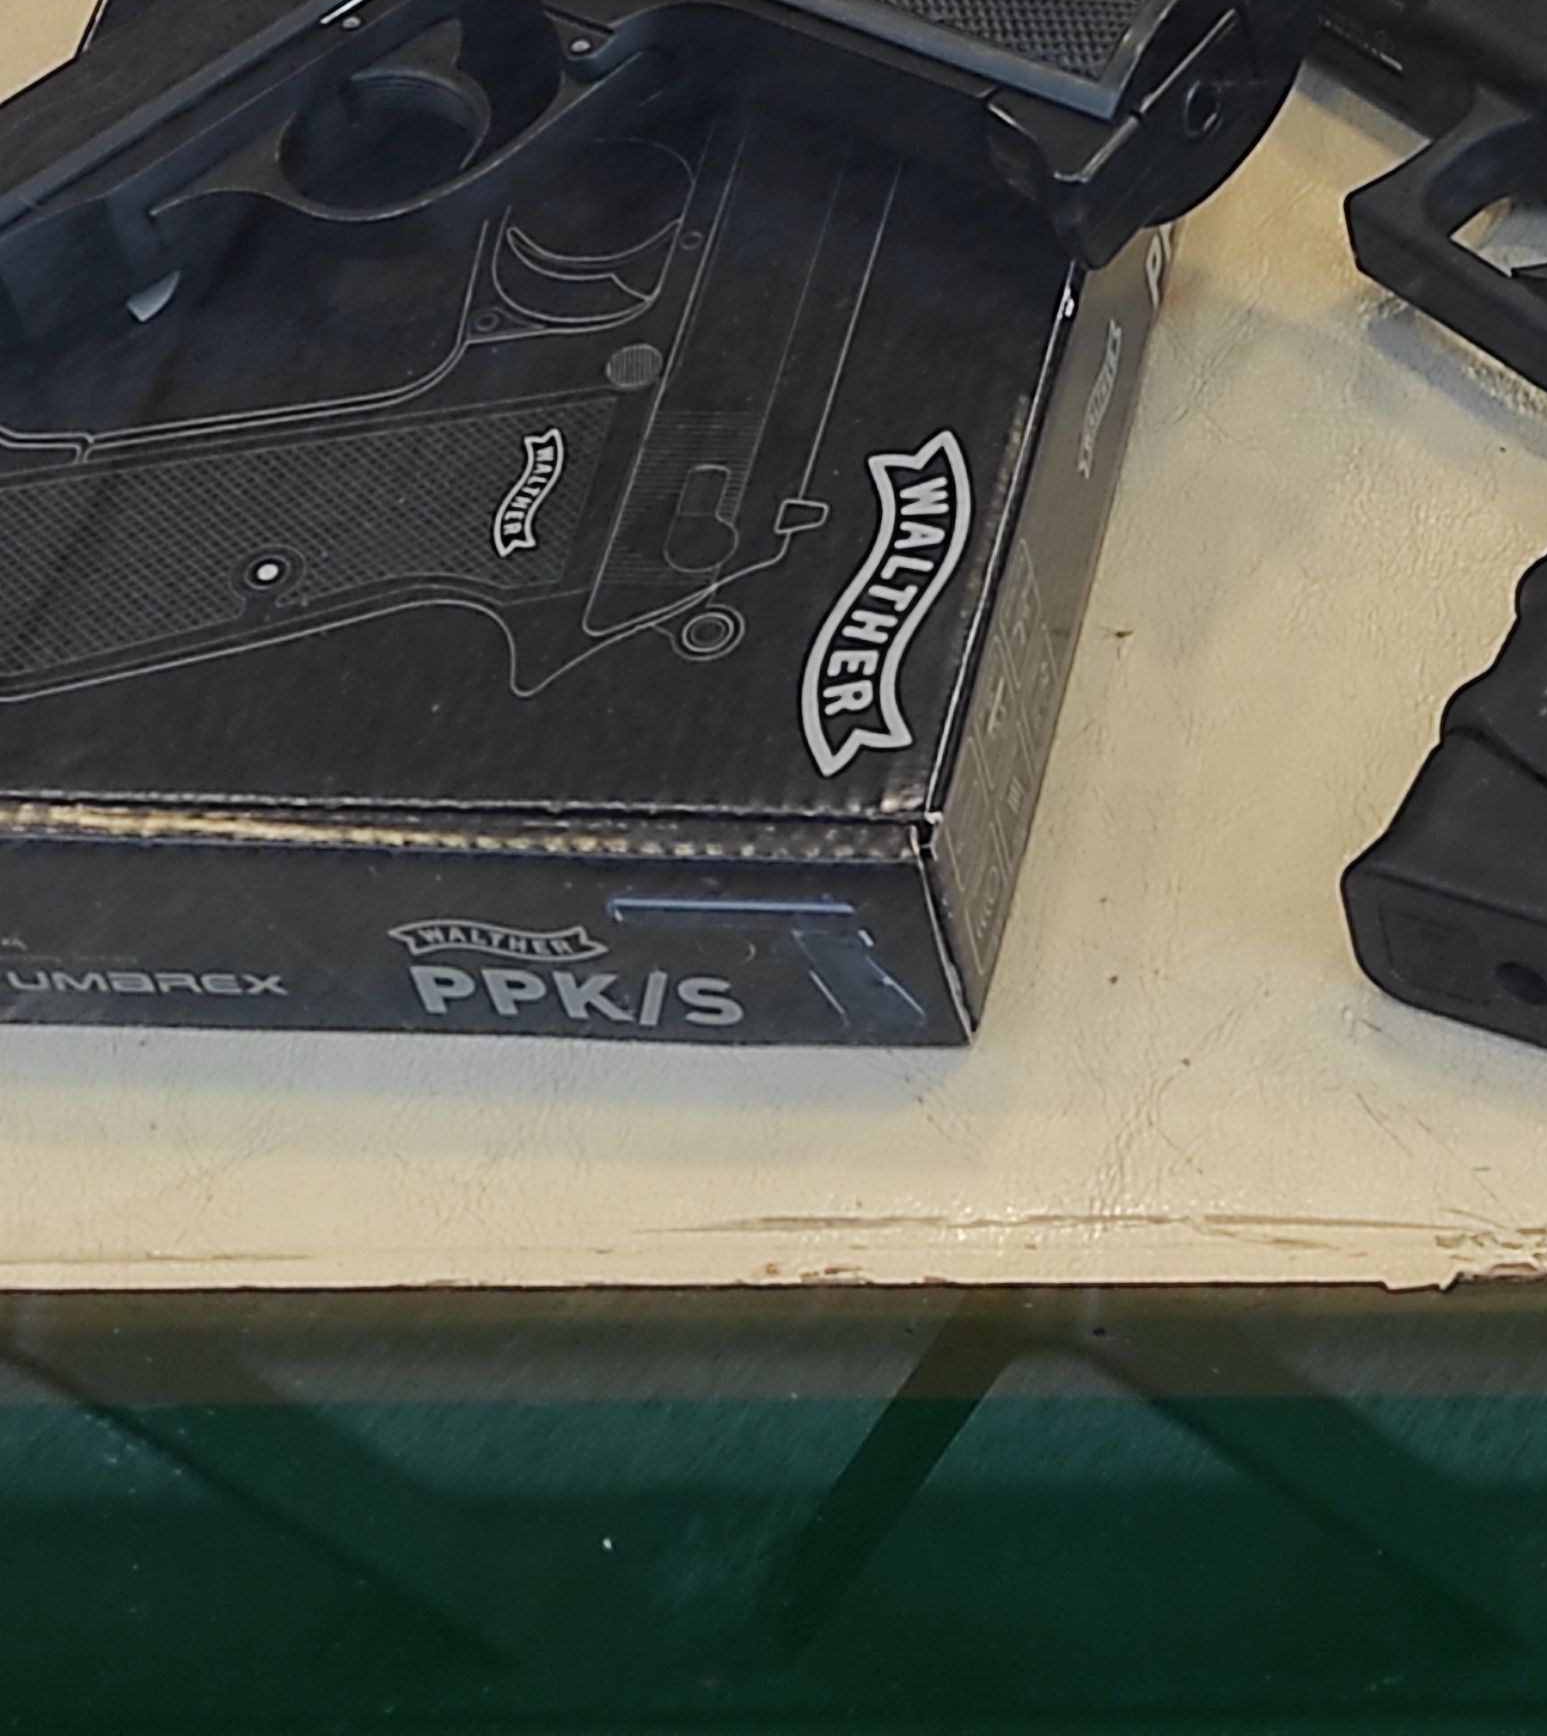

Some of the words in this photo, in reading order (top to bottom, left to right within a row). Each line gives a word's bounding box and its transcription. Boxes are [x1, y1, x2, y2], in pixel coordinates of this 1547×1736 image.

[503, 445, 555, 536] WALTHER
[822, 476, 950, 716] WALTHER
[417, 926, 577, 956] WALTHER
[6, 970, 288, 996] UMAREX
[408, 964, 744, 1027] PPK/S
